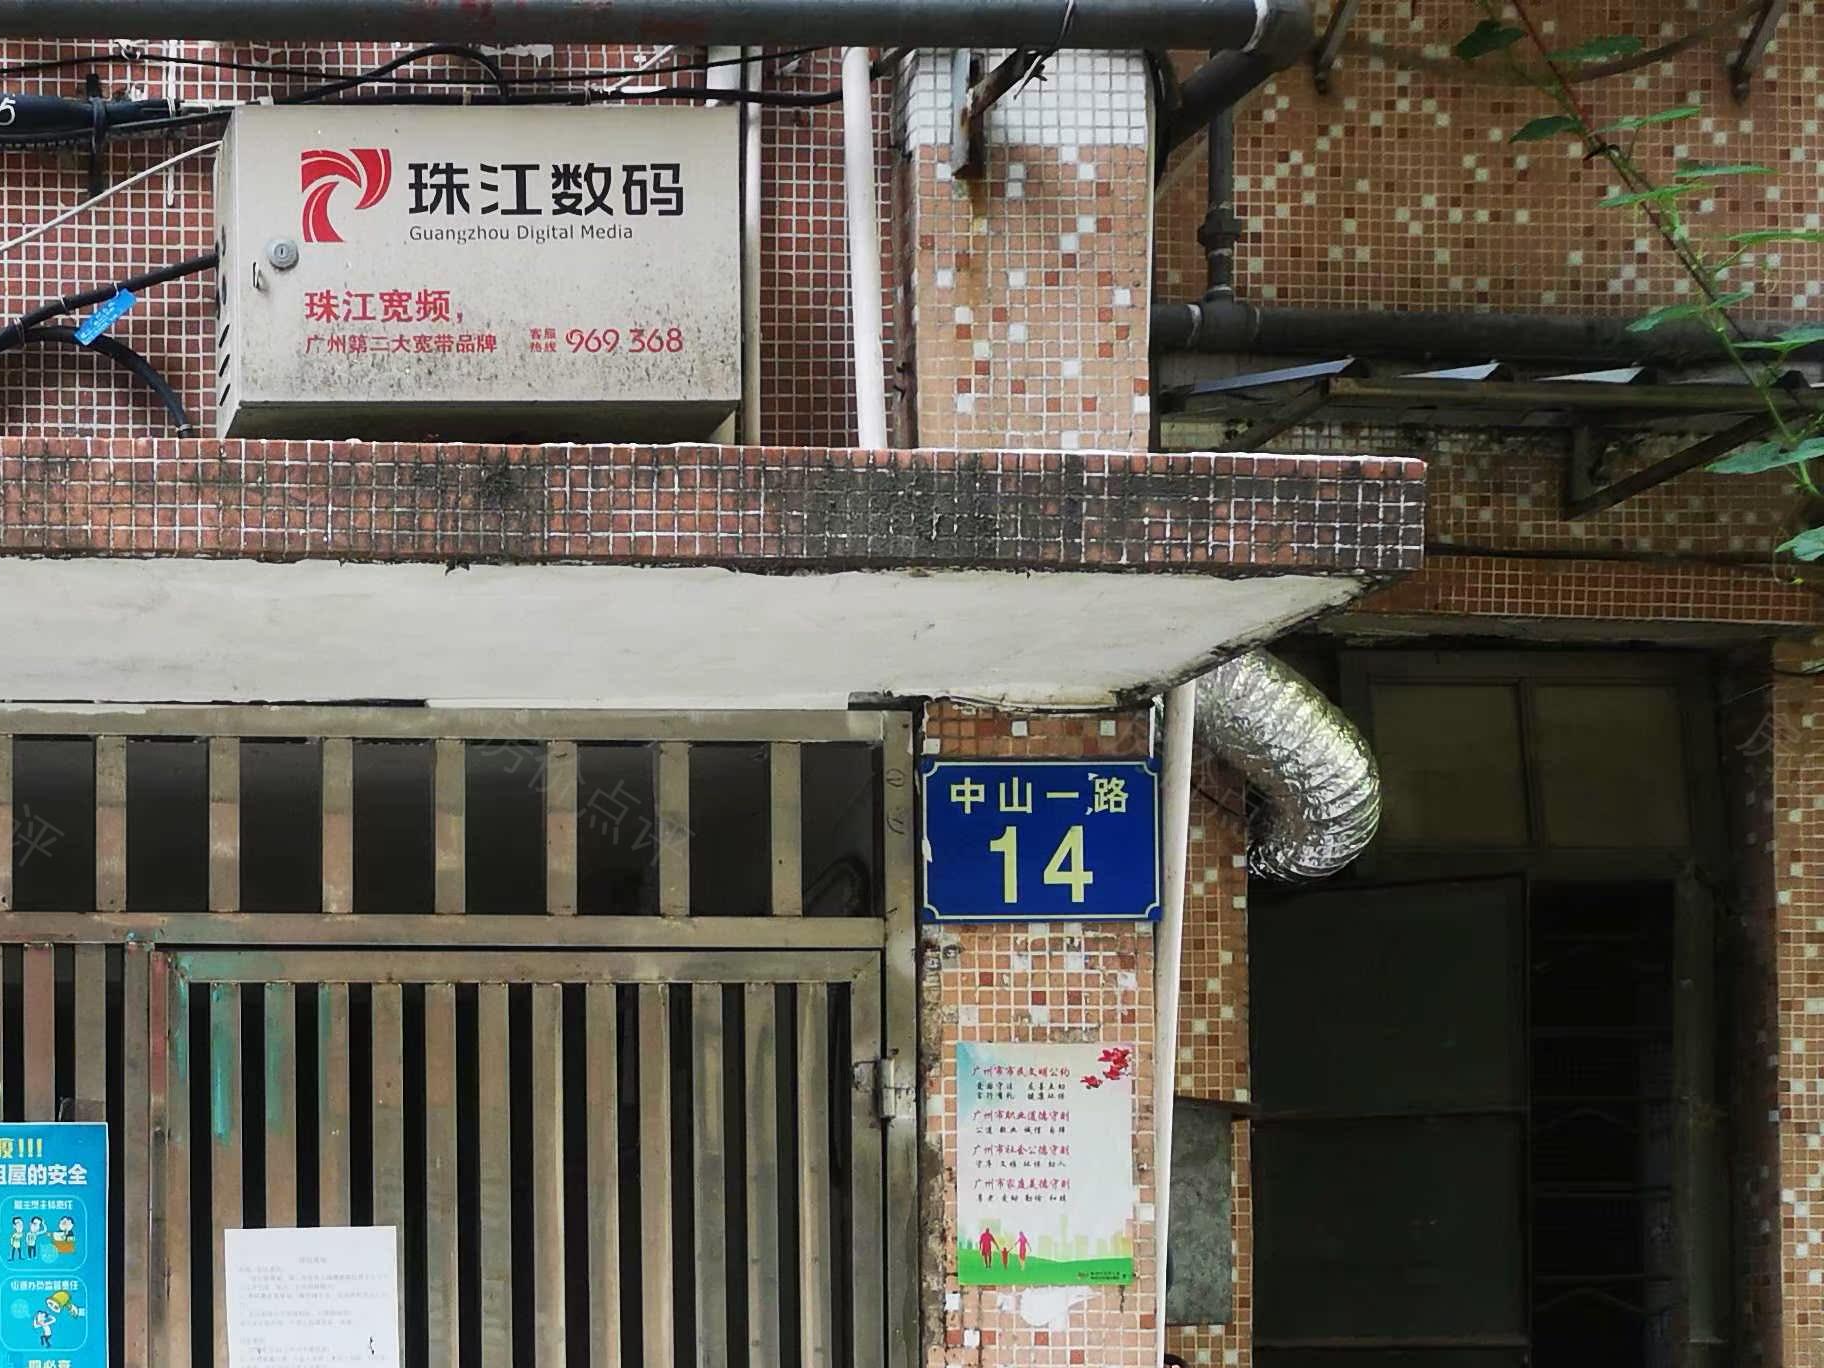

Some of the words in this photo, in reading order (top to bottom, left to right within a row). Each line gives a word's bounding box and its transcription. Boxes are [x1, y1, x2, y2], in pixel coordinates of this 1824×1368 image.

[408, 162, 684, 217] 珠江数码
[409, 225, 510, 244] Guangzhou
[517, 224, 575, 244] Digital
[581, 224, 633, 241] Media
[304, 333, 498, 355] 广州第二大宽带品牌
[565, 328, 620, 354] 969
[628, 327, 684, 354] 368
[950, 776, 1129, 814] 中山一路
[989, 825, 1094, 903] 14
